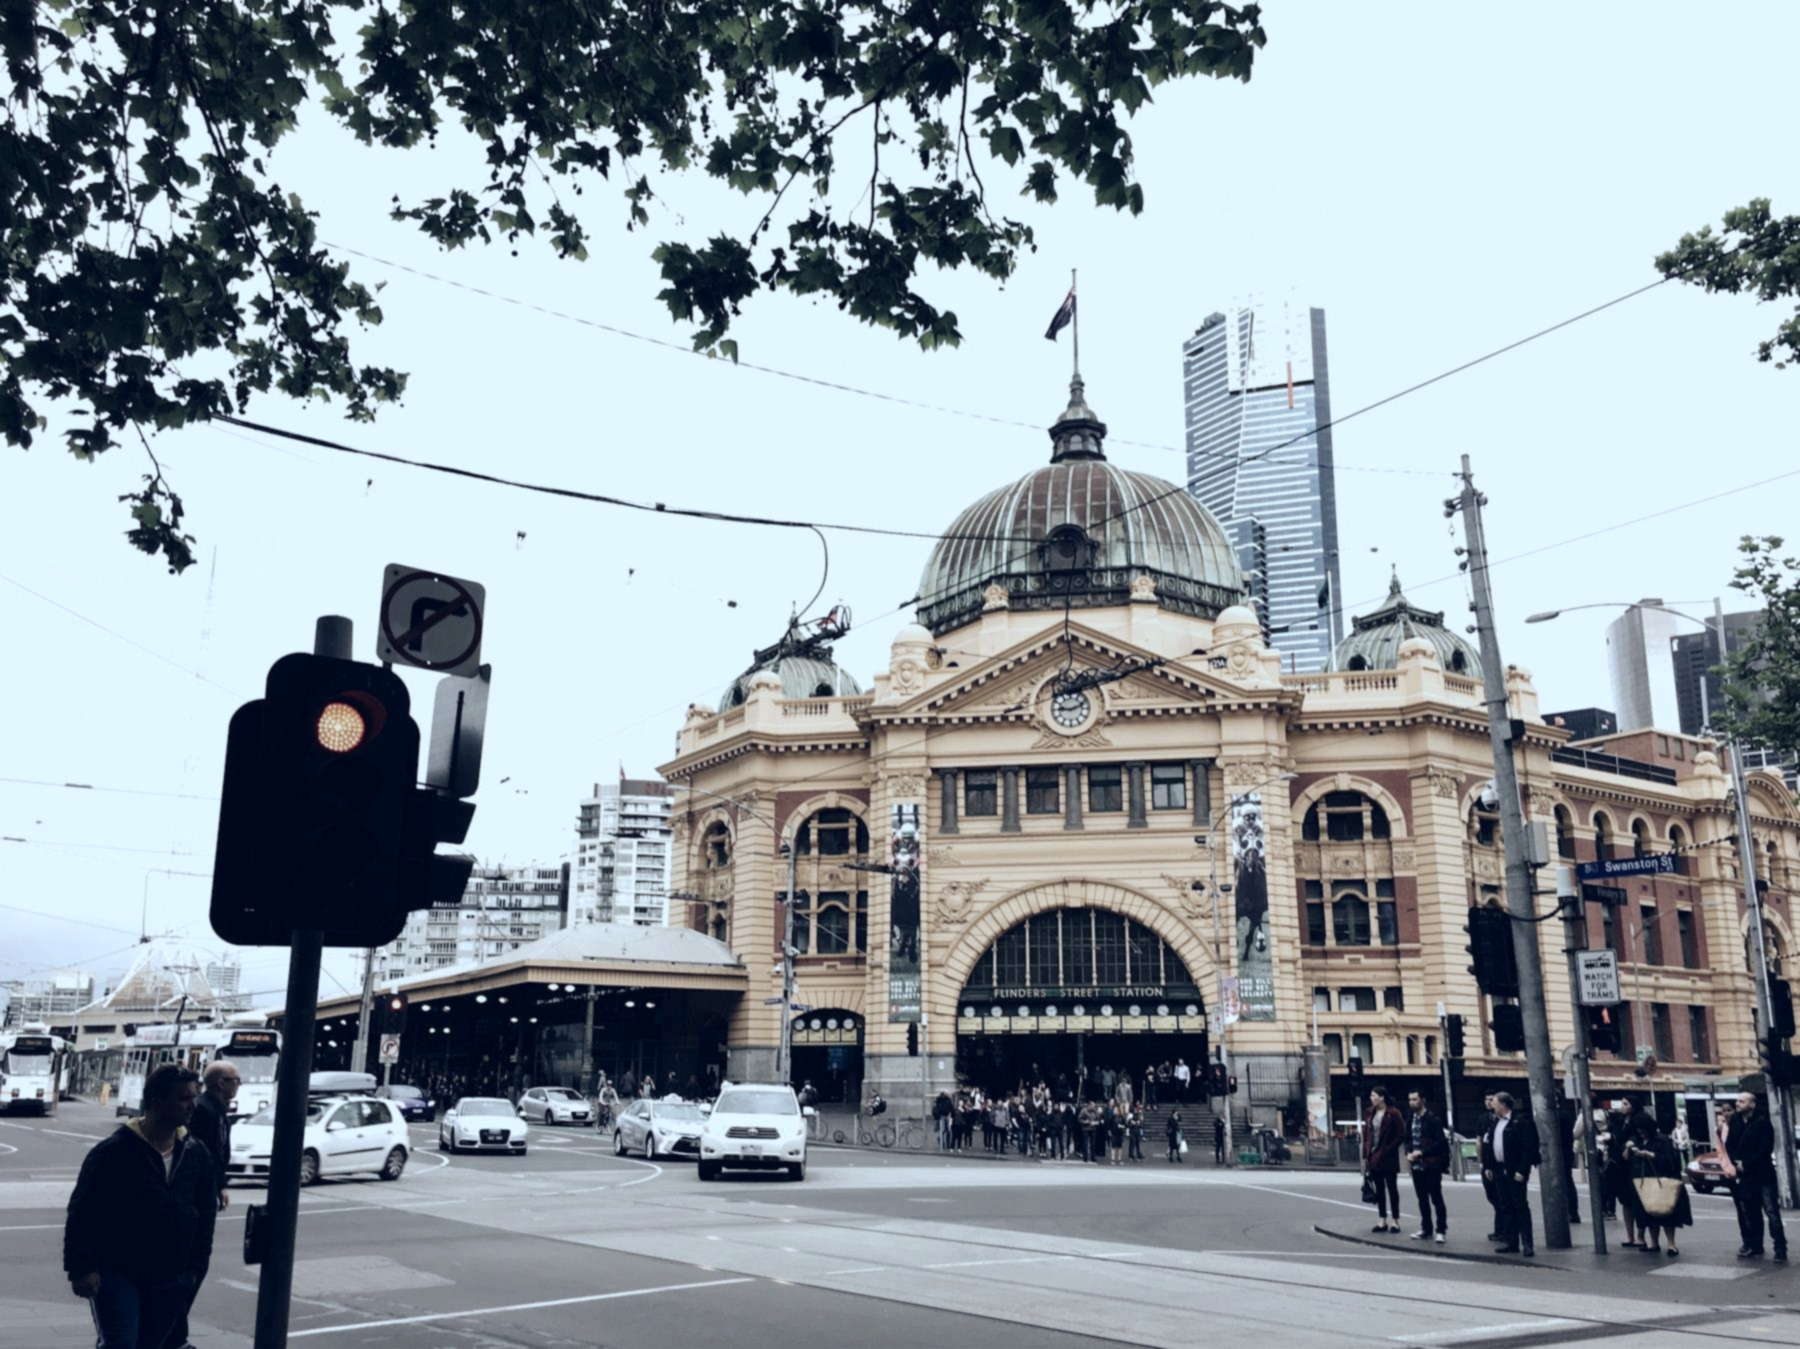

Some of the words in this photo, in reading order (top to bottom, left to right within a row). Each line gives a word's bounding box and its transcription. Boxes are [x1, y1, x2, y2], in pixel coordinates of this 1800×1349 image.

[1605, 858, 1658, 873] Swanston
[1661, 855, 1673, 868] St
[1584, 972, 1612, 981] WATCH
[1591, 982, 1608, 990] FOR
[993, 987, 1047, 999] FLINDERS
[1060, 986, 1100, 998] STREET
[1113, 986, 1163, 997] STATION
[1586, 990, 1614, 999] TRAMS
